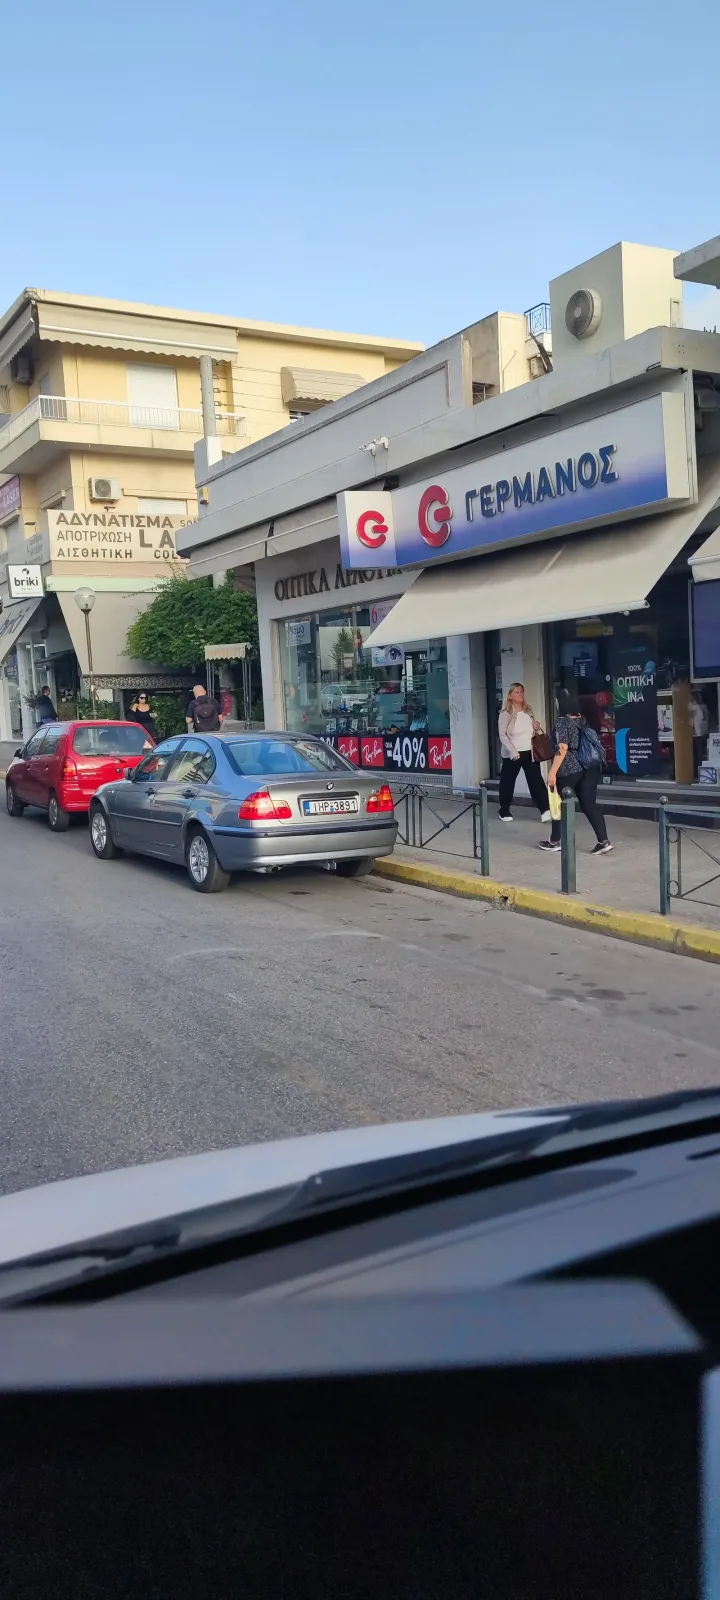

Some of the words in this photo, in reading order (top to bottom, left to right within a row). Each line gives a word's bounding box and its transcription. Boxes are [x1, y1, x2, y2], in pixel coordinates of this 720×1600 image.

[465, 444, 619, 522] ΓΕΡΜΑΝΟΣ
[56, 512, 174, 529] ΑΔΥΝΑΤΙΣΜΑ
[57, 530, 132, 543] ΑΠΟΤΡΙΧΩΣΗ
[57, 548, 133, 559] ΑΙΣΘΗΤΙΚΗ
[154, 549, 190, 560] COL
[14, 576, 39, 587] briki
[274, 567, 331, 601] ΟΠΤΙΚΑ
[627, 664, 642, 672] 100%
[617, 674, 654, 688] ΟΠΤΙΚΗ
[627, 691, 645, 703] ΙΝΑ
